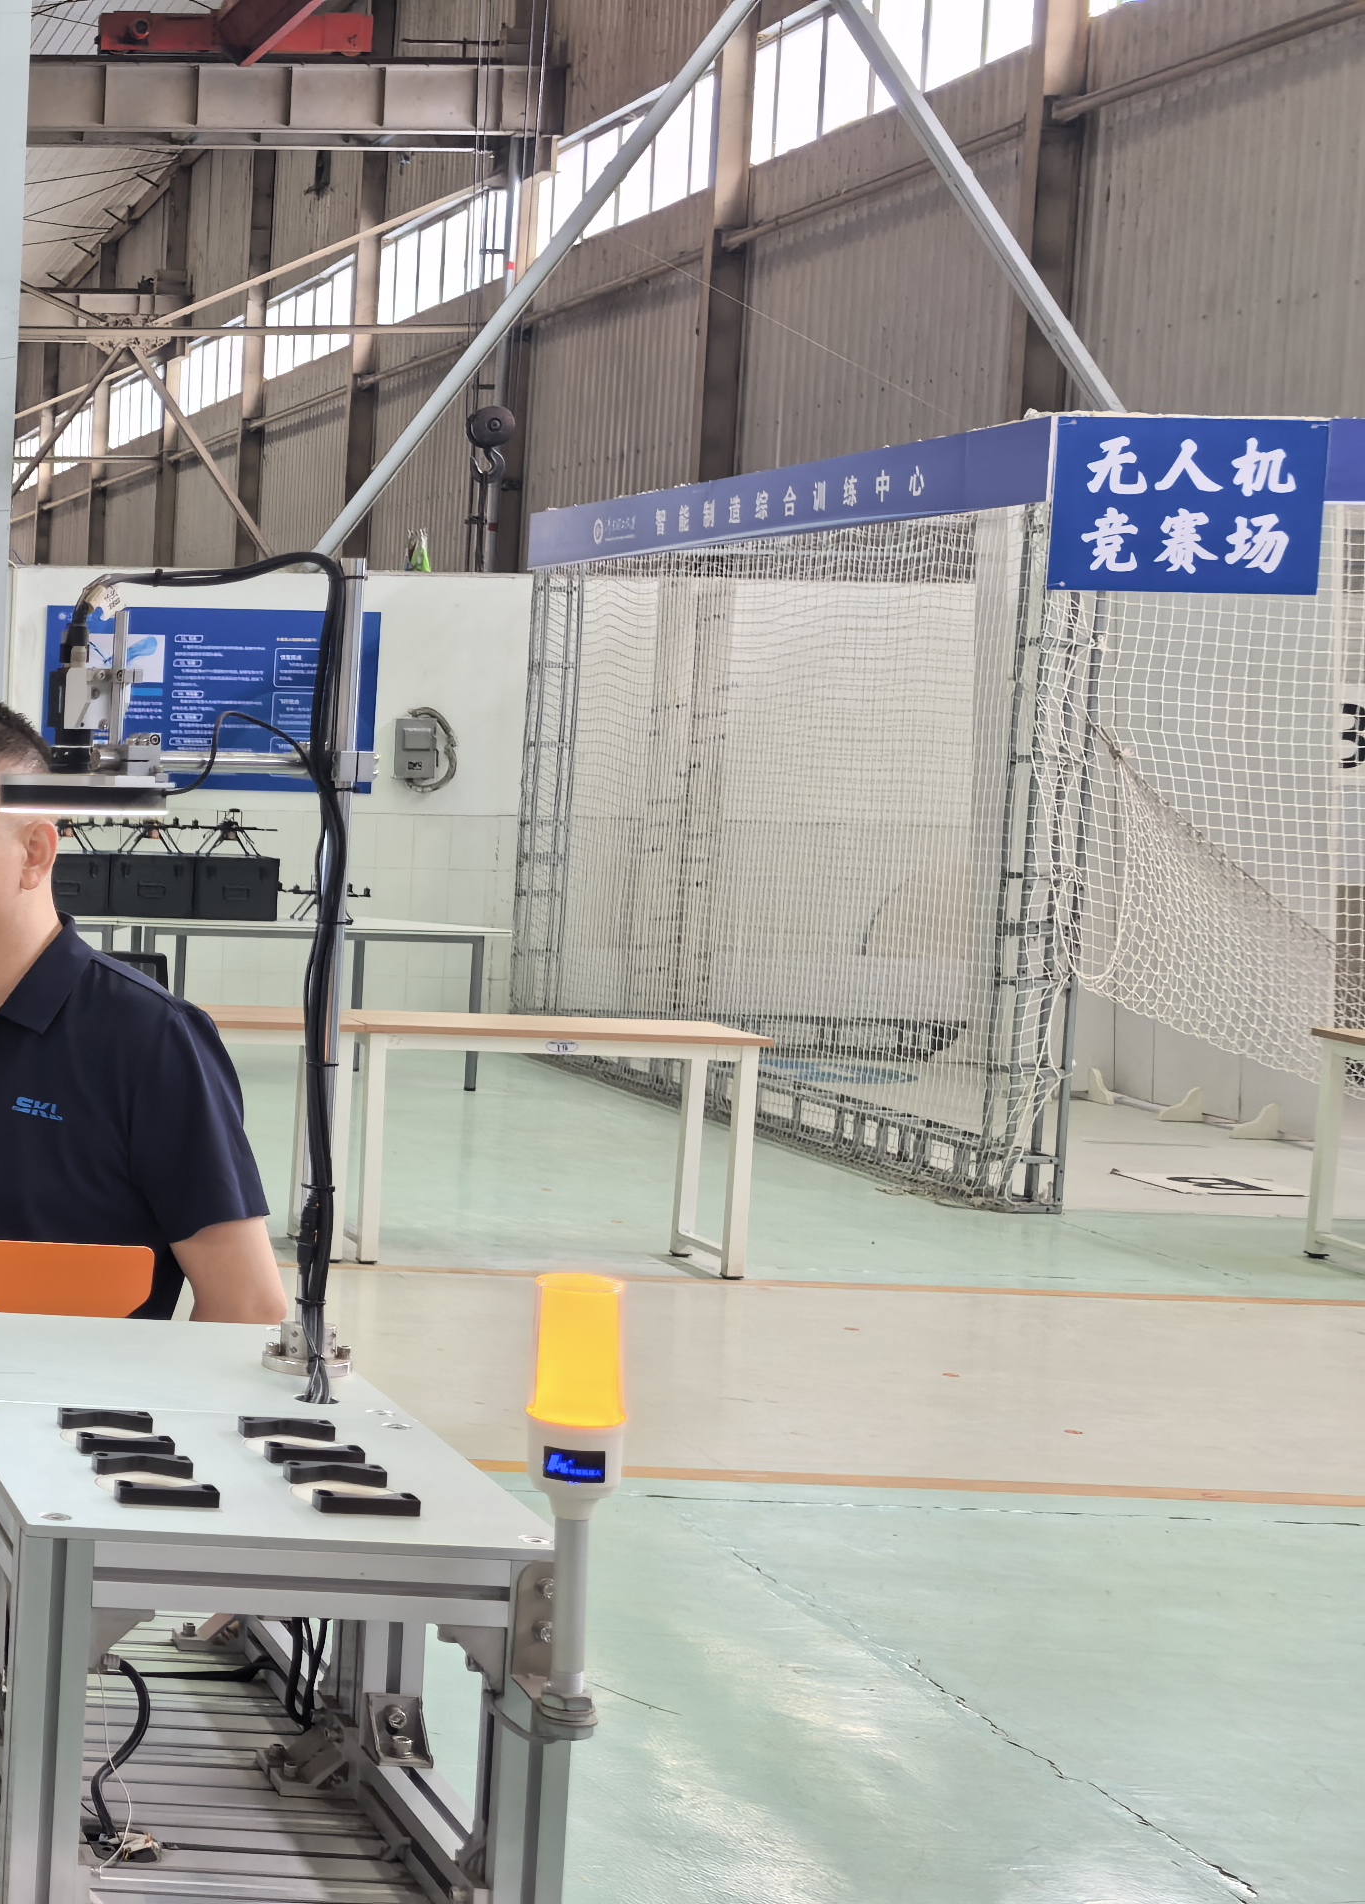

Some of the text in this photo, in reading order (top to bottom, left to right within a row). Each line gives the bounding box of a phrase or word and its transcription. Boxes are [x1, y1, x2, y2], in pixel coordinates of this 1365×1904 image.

[1087, 436, 1296, 496] 无人机
[655, 466, 925, 536] 智能制造综合训练中心
[1081, 507, 1289, 574] 竞赛场
[12, 1096, 63, 1121] SKL
